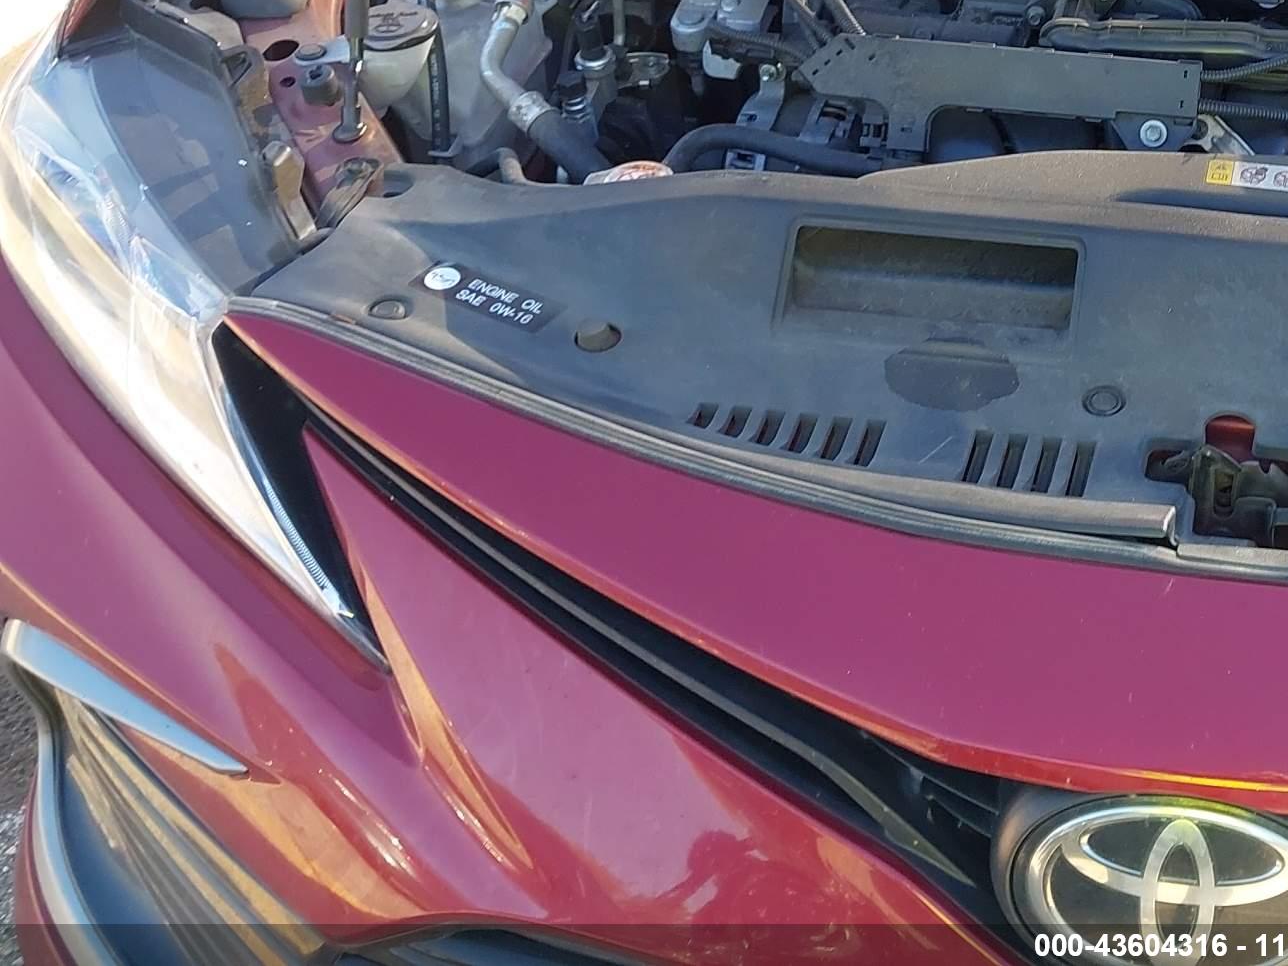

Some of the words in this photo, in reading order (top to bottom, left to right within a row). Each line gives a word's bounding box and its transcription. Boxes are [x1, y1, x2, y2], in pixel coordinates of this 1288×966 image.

[455, 288, 487, 307] SAE
[467, 278, 519, 304] ENGINE
[521, 298, 544, 315] OIL
